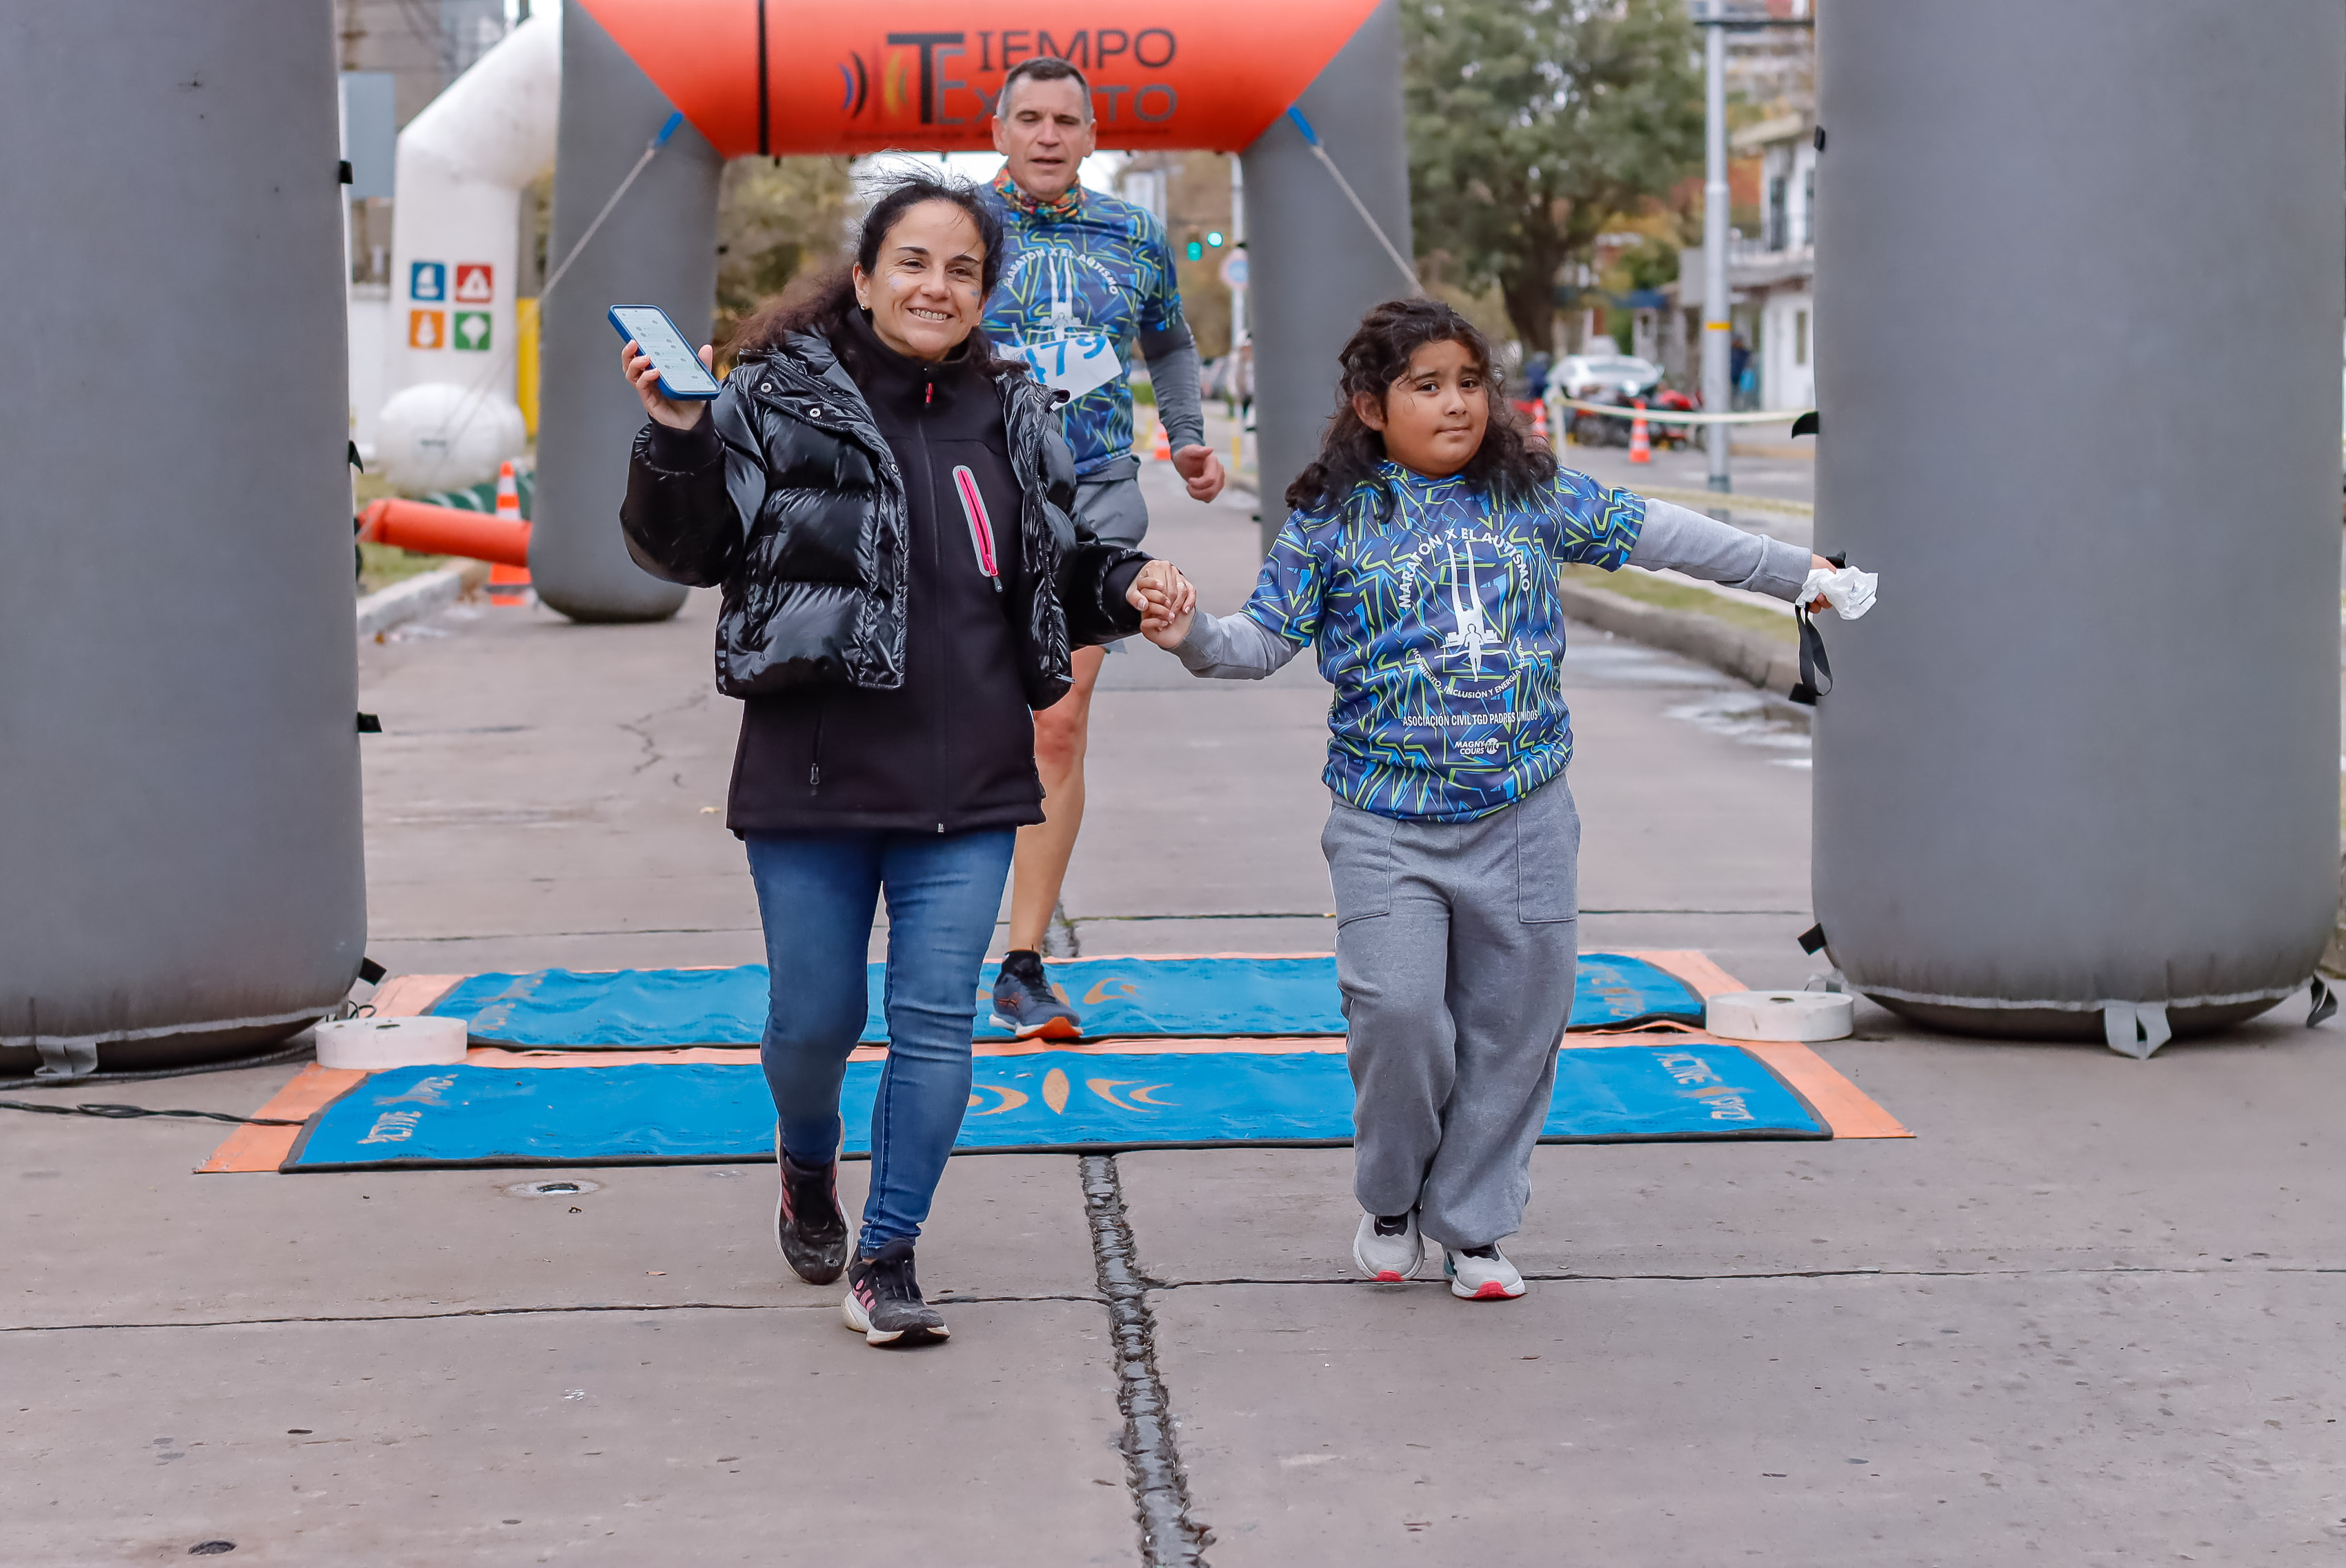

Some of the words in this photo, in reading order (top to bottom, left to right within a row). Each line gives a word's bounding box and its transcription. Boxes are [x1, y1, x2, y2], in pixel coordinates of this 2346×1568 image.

[886, 28, 1178, 125] TIEMPO
[1077, 253, 1118, 295] AUTISMO
[1444, 528, 1458, 540] X
[1461, 527, 1477, 540] EL
[1482, 532, 1530, 591] AUTISMO
[1444, 685, 1488, 699] INCLUSIÓN
[1487, 690, 1493, 698] Y
[1494, 669, 1522, 694] ENERGÍA
[1402, 712, 1449, 726] ASOCIACIÓN
[1451, 715, 1472, 726] CIVIL
[1472, 714, 1488, 725] TGD
[1489, 712, 1516, 724] PADRES
[1517, 709, 1538, 722] UNIDOS
[1455, 740, 1485, 748] MAGNY
